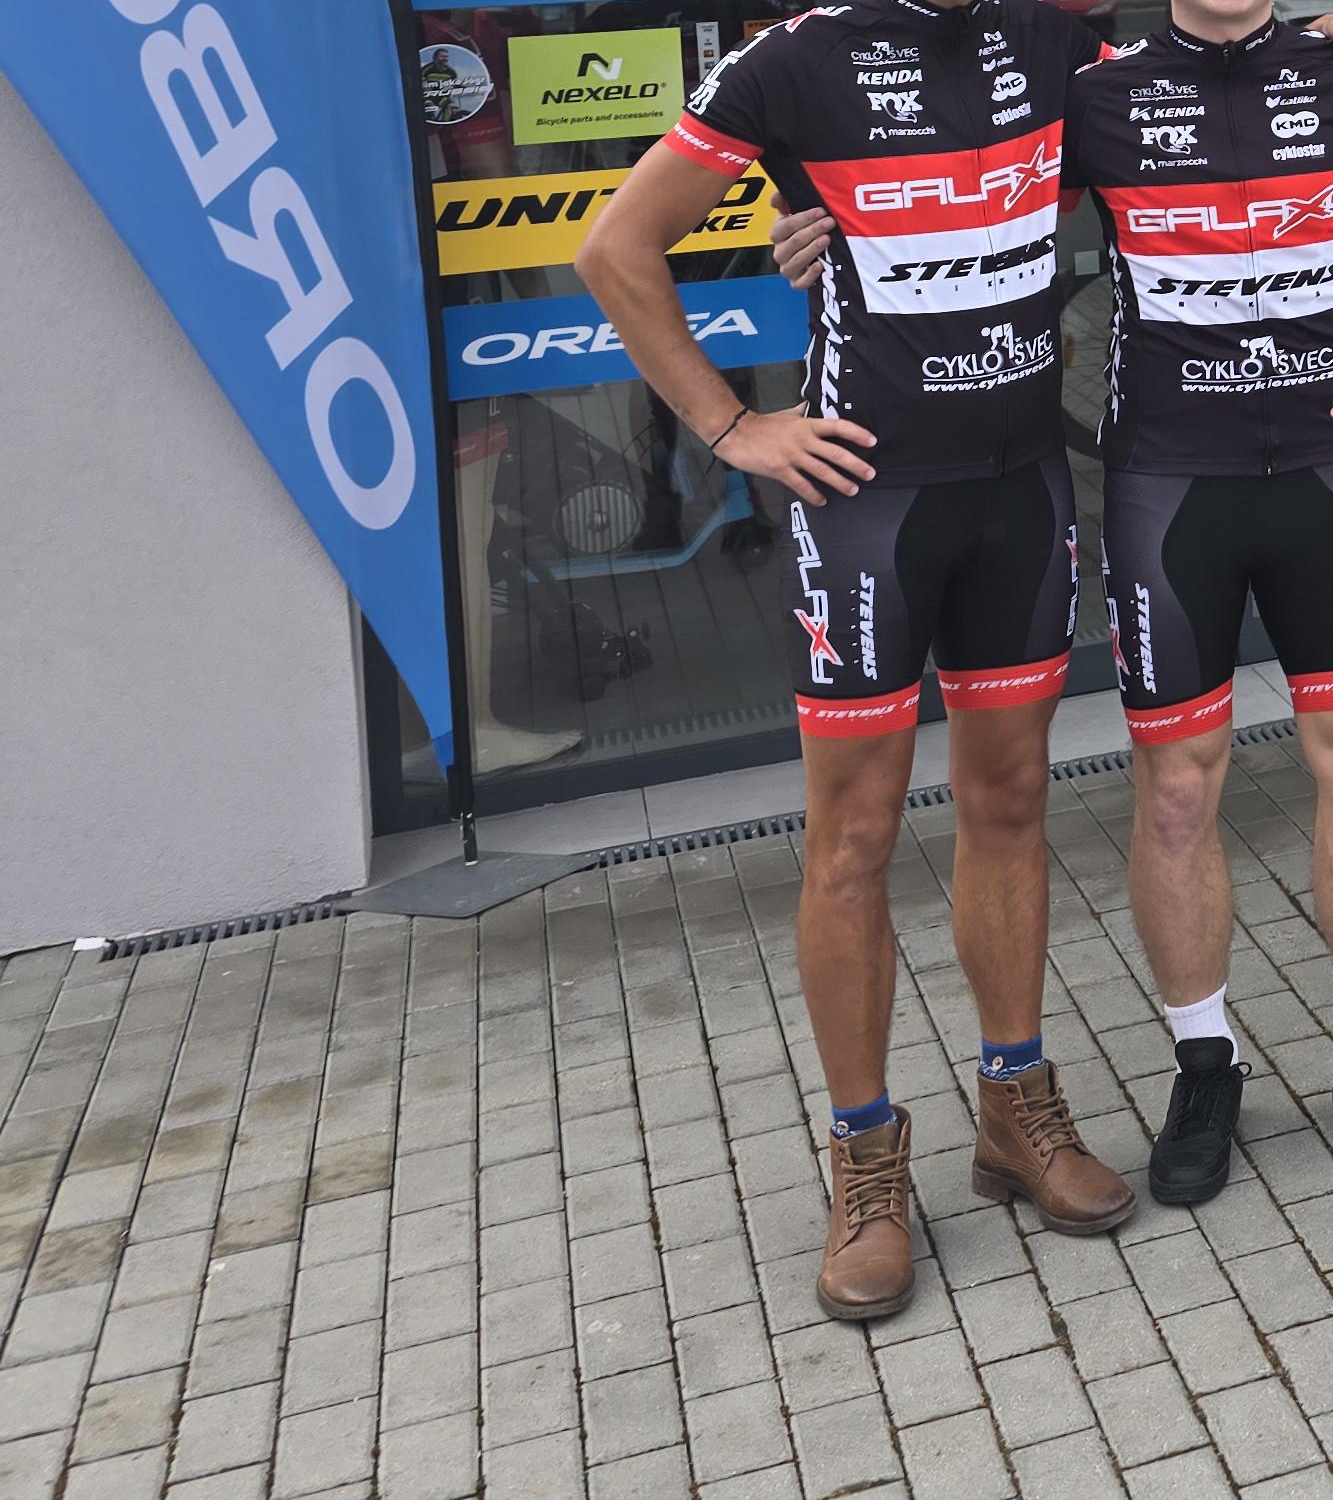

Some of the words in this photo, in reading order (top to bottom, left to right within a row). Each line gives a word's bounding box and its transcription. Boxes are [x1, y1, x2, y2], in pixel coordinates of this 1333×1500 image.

[856, 68, 923, 86] KENDA
[866, 89, 923, 119] FOX
[1153, 105, 1206, 119] KENDA
[536, 117, 569, 127] Bicycle
[570, 115, 593, 125] parts
[595, 113, 612, 122] and
[613, 110, 664, 121] accessories
[1276, 117, 1316, 131] KMC
[1140, 124, 1198, 151] FOX
[434, 176, 767, 232] UNID
[922, 350, 1003, 379] CYKLO
[1013, 328, 1053, 365] ŠVEC
[1181, 356, 1264, 380] CYKLO
[790, 500, 845, 685] GALAXY
[859, 571, 878, 681] STEVENS
[1134, 582, 1157, 695] STEVENS
[967, 671, 1050, 692] STEVENS
[815, 702, 898, 719] STEVENS
